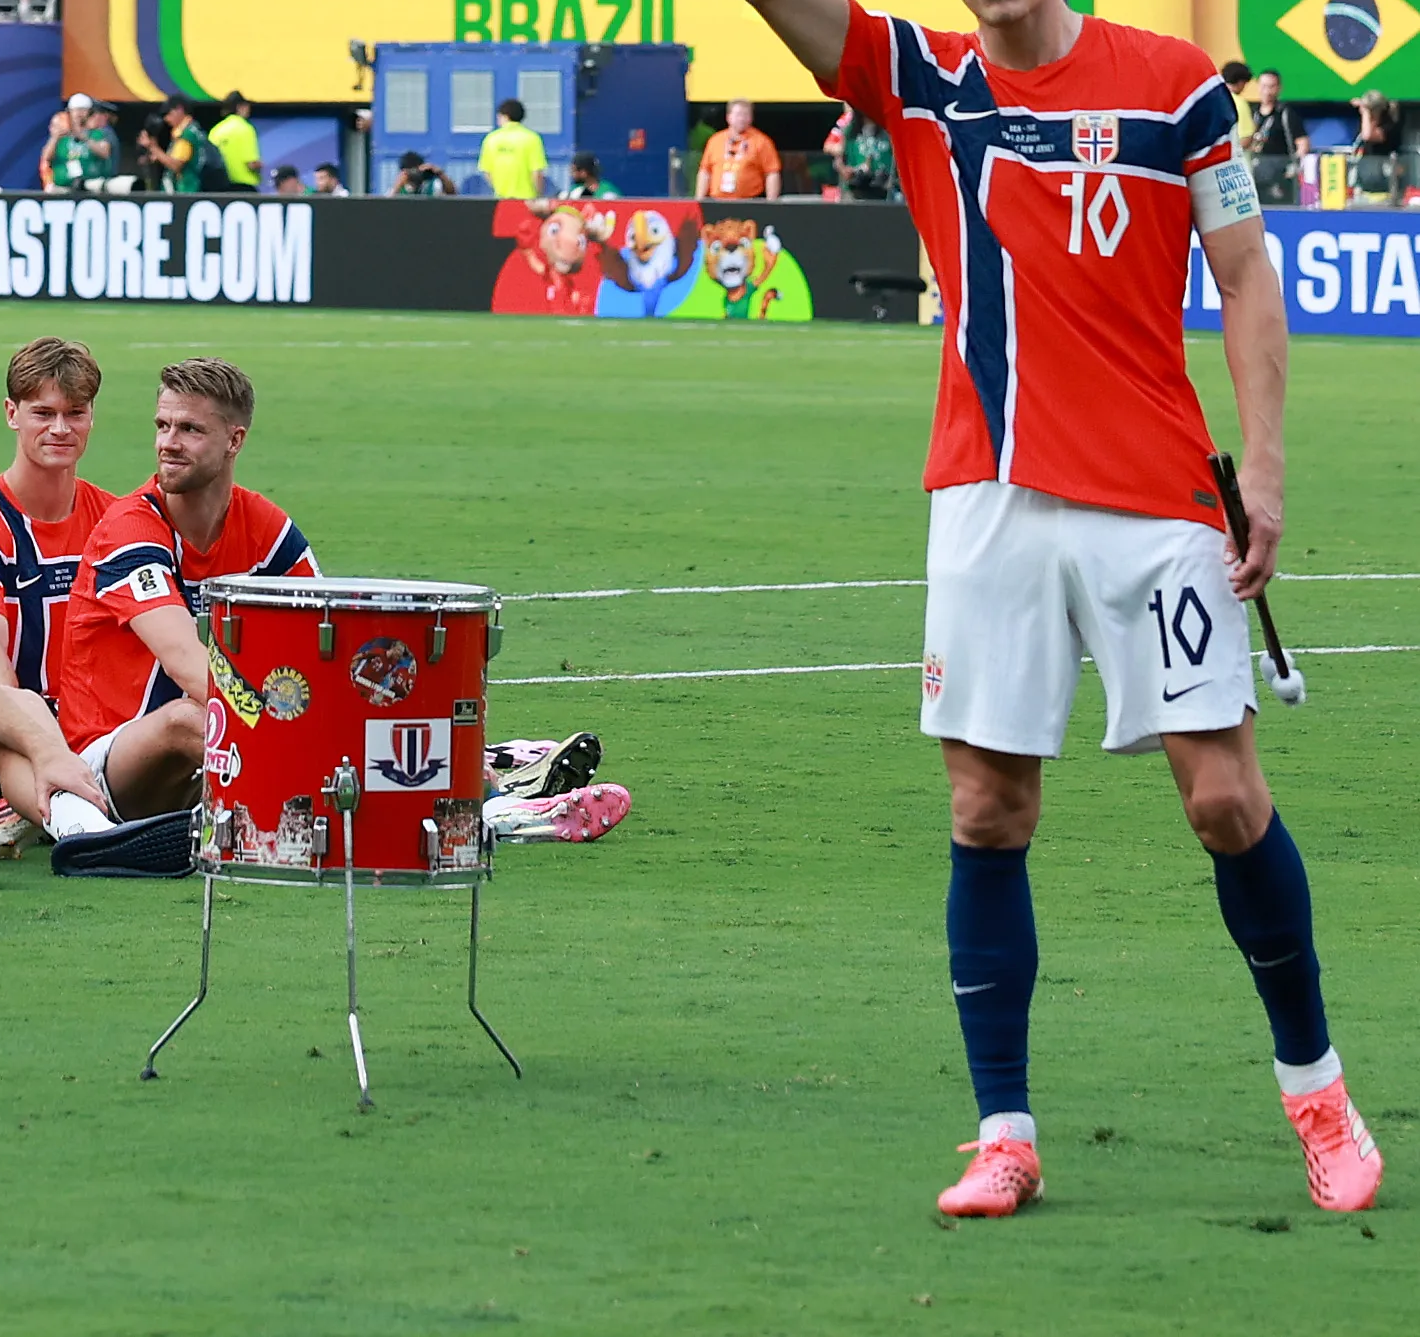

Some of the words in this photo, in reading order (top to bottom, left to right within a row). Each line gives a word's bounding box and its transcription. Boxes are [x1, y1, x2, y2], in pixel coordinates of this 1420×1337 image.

[1061, 172, 1130, 257] 10
[1296, 231, 1420, 315] STA
[1148, 586, 1213, 669] 10
